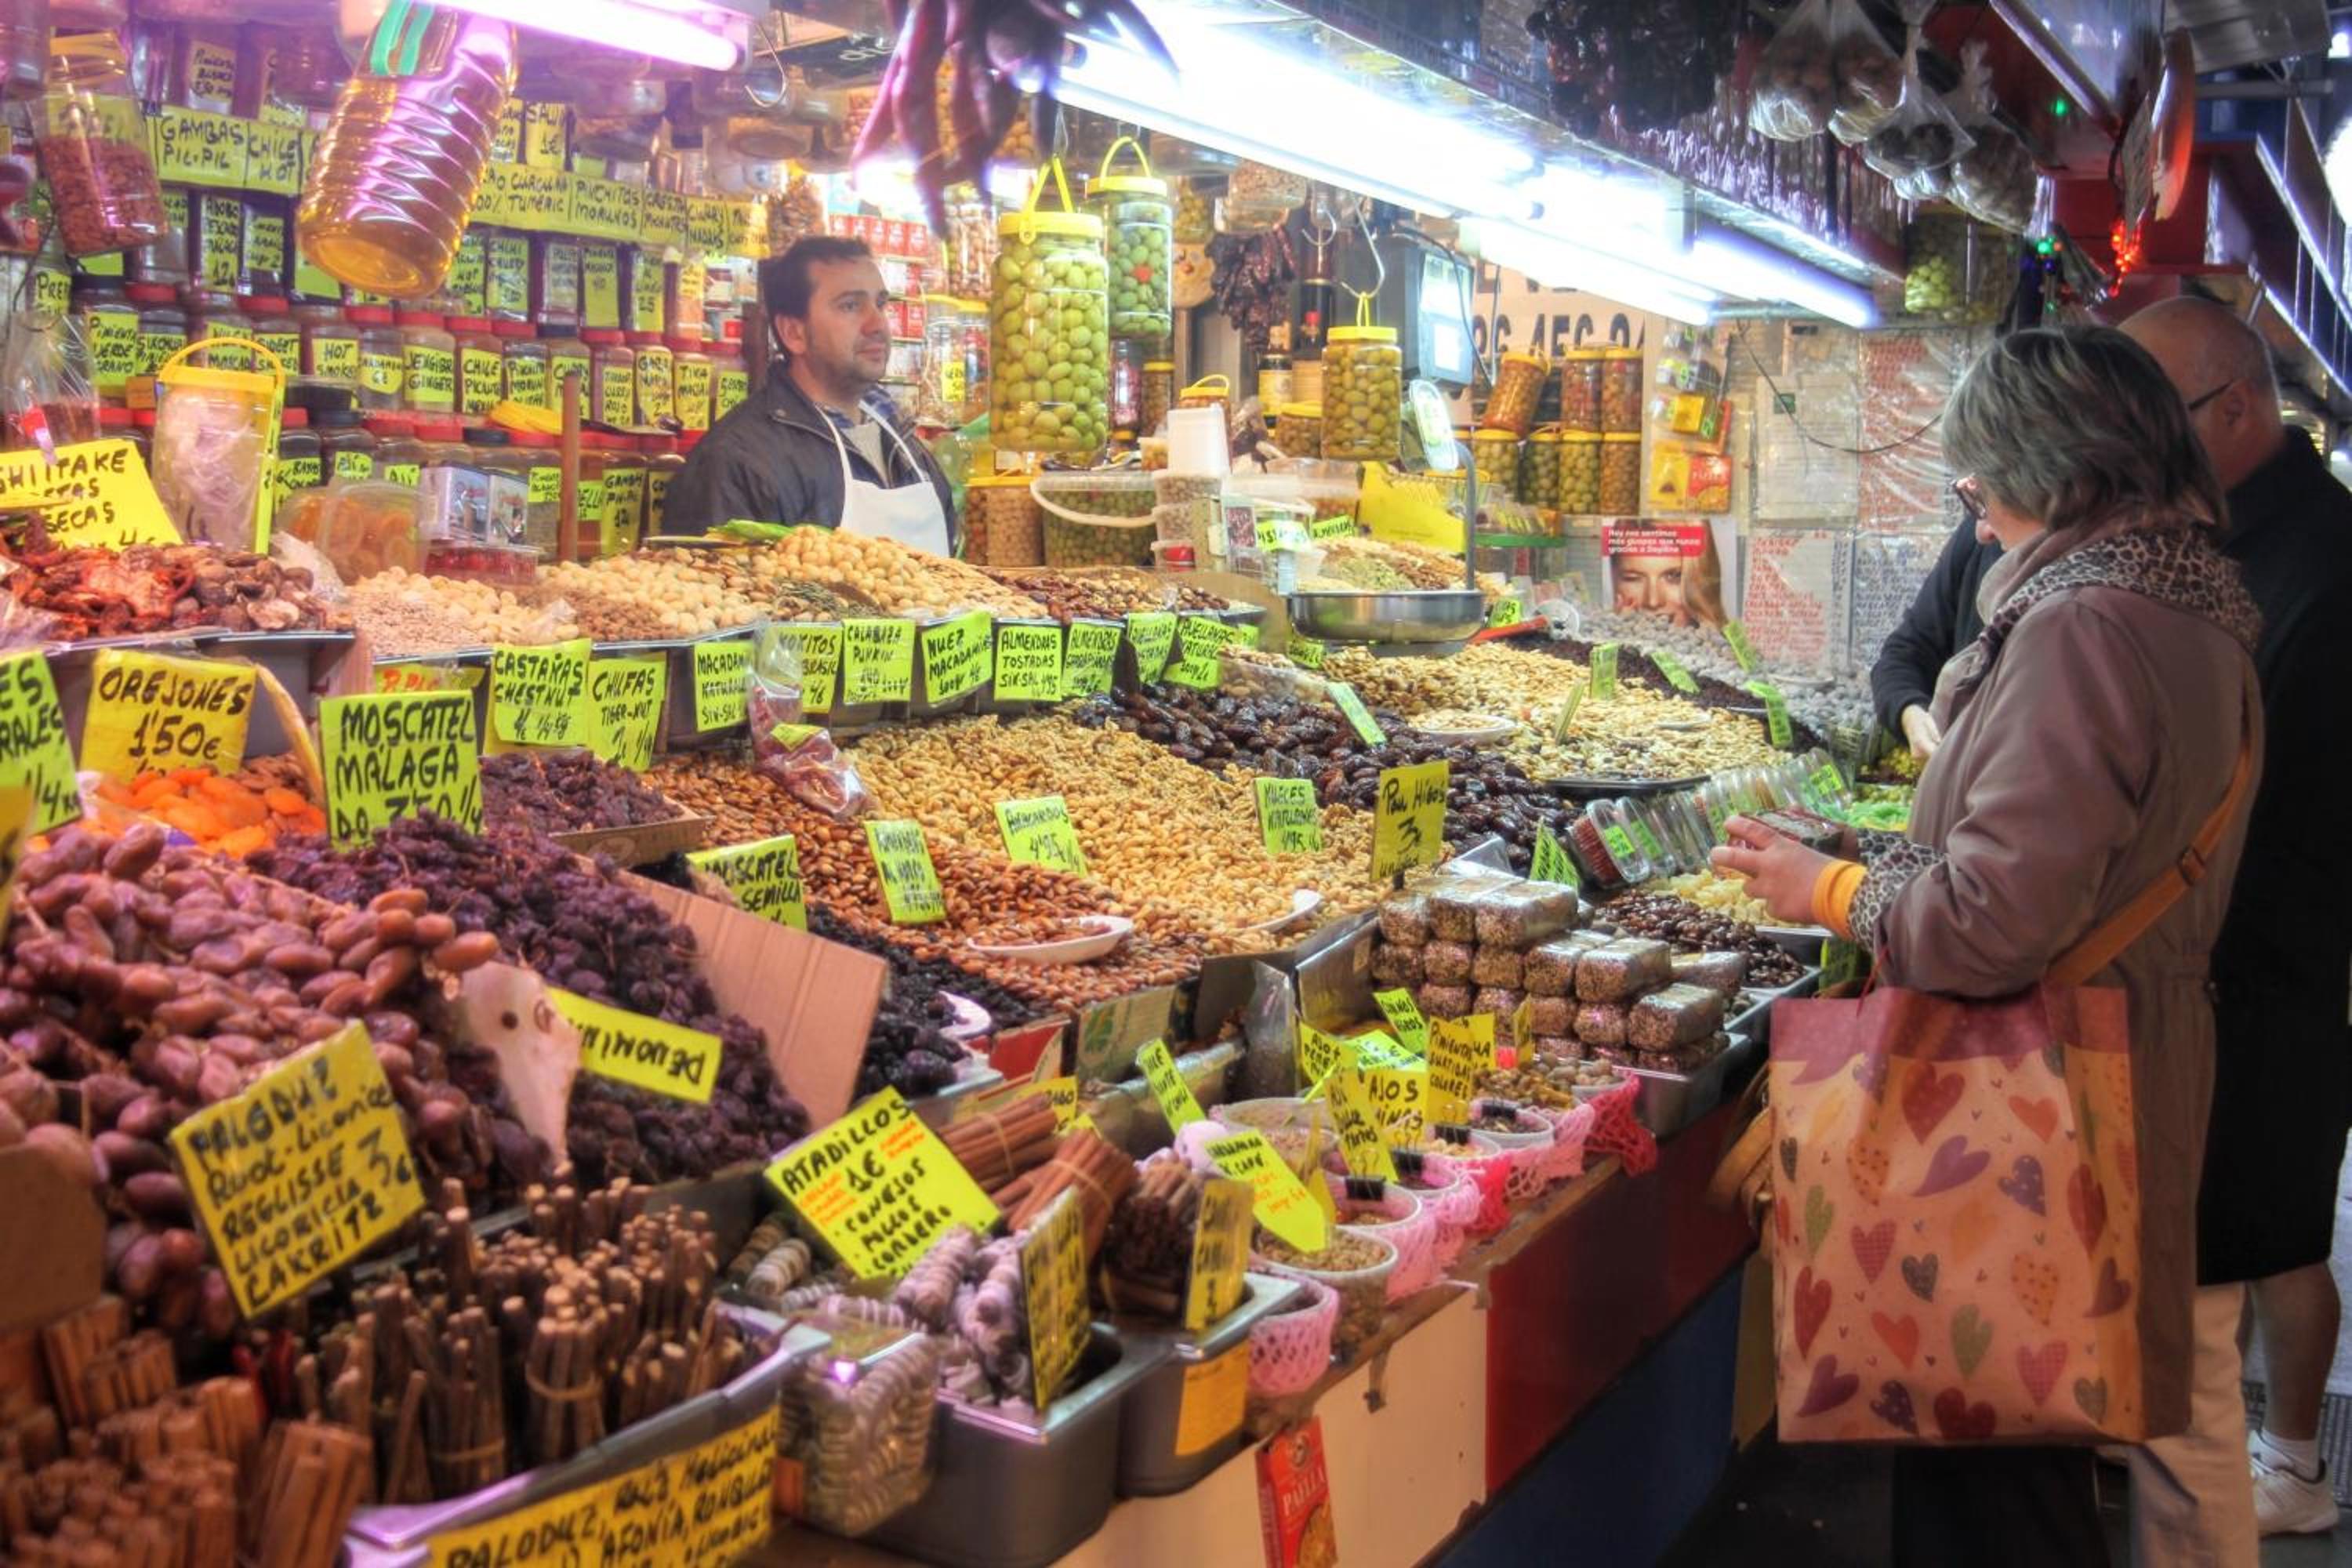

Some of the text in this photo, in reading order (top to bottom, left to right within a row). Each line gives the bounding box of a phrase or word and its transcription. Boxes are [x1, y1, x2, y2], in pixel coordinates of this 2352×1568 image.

[161, 116, 244, 144] GAMBAS
[927, 628, 965, 659] NUEZ
[1001, 630, 1058, 653] ALMENDRAS
[495, 649, 583, 685] CASTAÑAS
[1003, 654, 1054, 670] TOSTADAS
[100, 667, 252, 716] OREJONES
[591, 667, 655, 702] CHUFAS
[341, 697, 474, 753] MOSCATEL
[1368, 1075, 1418, 1102] AJOS
[782, 1098, 911, 1196] ATADILLOS
